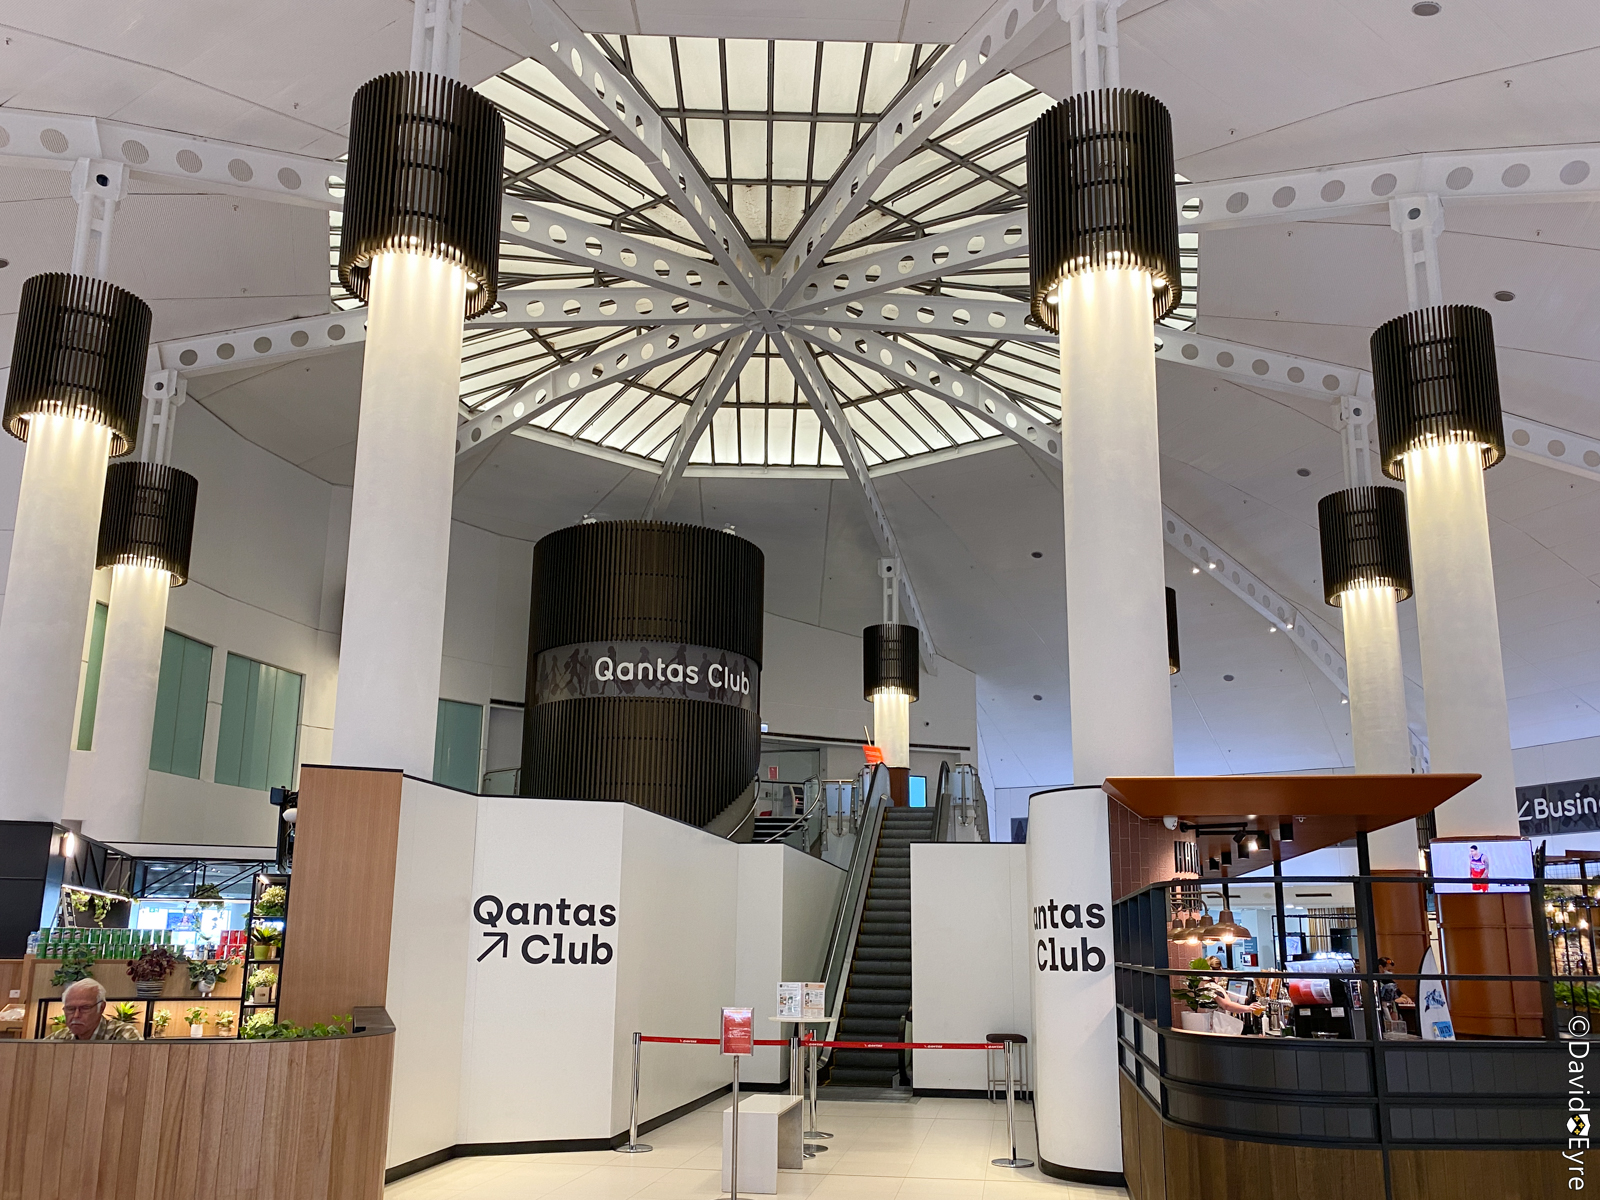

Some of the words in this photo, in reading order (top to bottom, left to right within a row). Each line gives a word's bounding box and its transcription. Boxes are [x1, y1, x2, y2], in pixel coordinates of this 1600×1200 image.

[594, 656, 699, 685] Qantas
[708, 663, 750, 695] Club
[1533, 792, 1600, 819] Busin
[473, 894, 617, 928] Qantas
[521, 933, 614, 965] Club
[1037, 936, 1106, 972] Club
